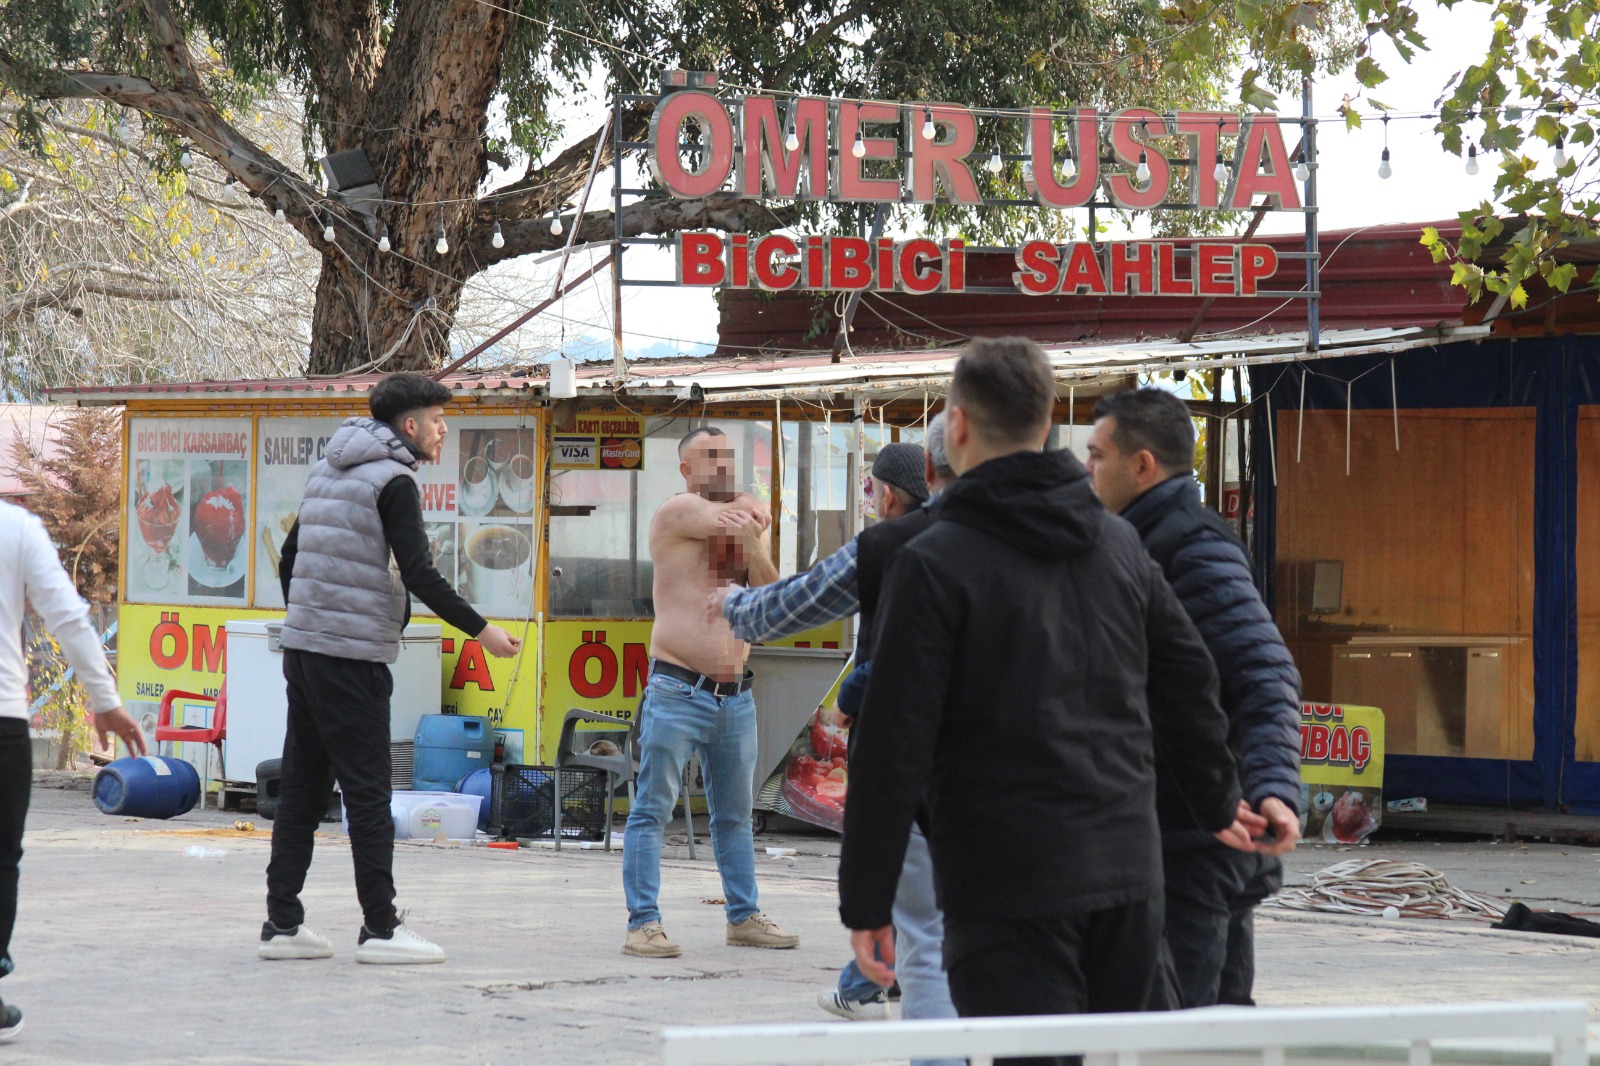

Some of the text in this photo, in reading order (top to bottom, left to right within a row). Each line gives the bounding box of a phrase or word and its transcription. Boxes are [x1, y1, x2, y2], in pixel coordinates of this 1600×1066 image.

[651, 70, 1301, 211] ÖMER USTA
[1013, 239, 1278, 296] SAHLEP
[264, 437, 314, 465] SAHLEP
[561, 447, 590, 458] VISA
[602, 449, 641, 458] MasterCard
[136, 682, 164, 697] SAHLEP
